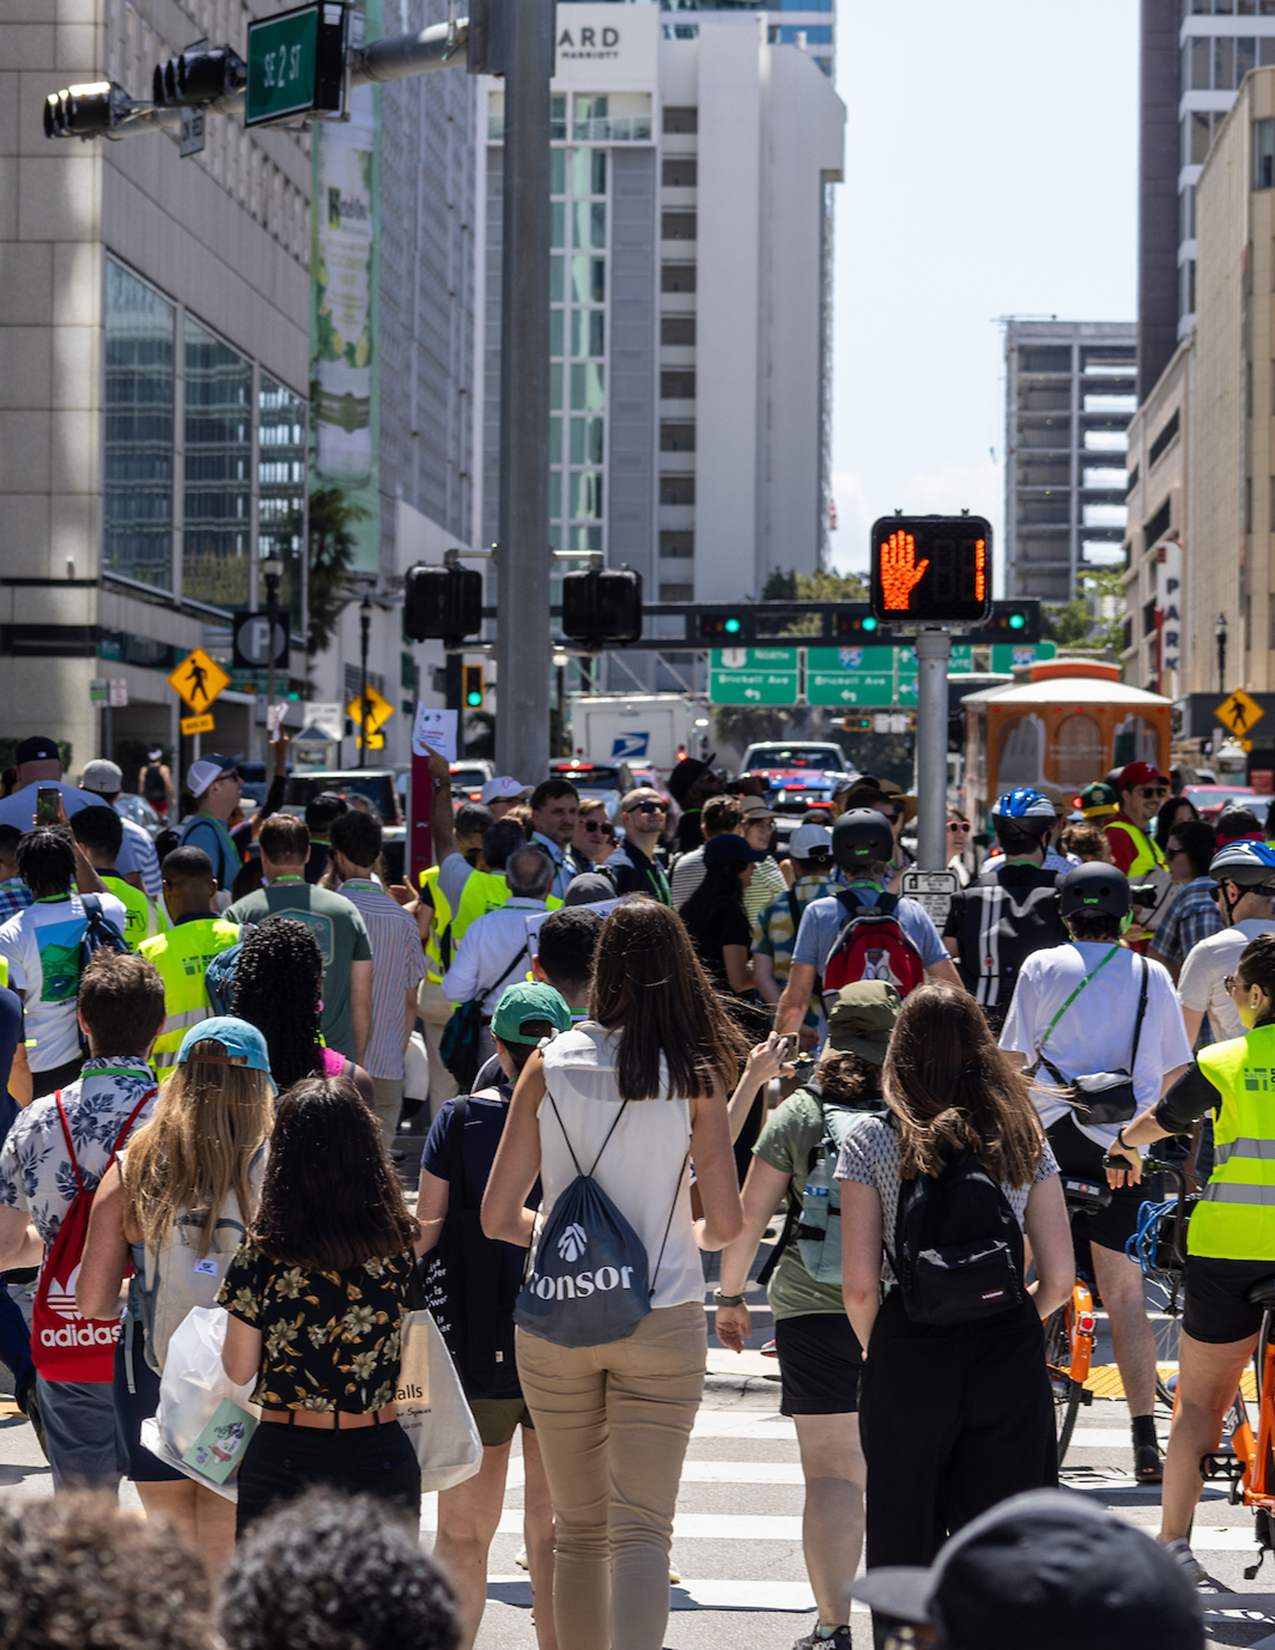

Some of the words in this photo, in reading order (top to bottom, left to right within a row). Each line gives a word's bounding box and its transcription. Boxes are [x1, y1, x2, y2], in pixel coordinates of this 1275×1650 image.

[558, 27, 620, 48] ARD
[264, 52, 277, 88] SE
[277, 44, 287, 88] 2
[289, 44, 301, 80] ST
[561, 51, 619, 60] MARRIOTT
[975, 538, 985, 602] 1
[1164, 578, 1180, 670] PARK
[251, 622, 271, 660] P
[718, 674, 763, 684] Brickell
[767, 675, 789, 684] Ave
[814, 676, 859, 686] Brickell
[865, 676, 886, 686] Ave
[41, 1323, 122, 1347] adidas
